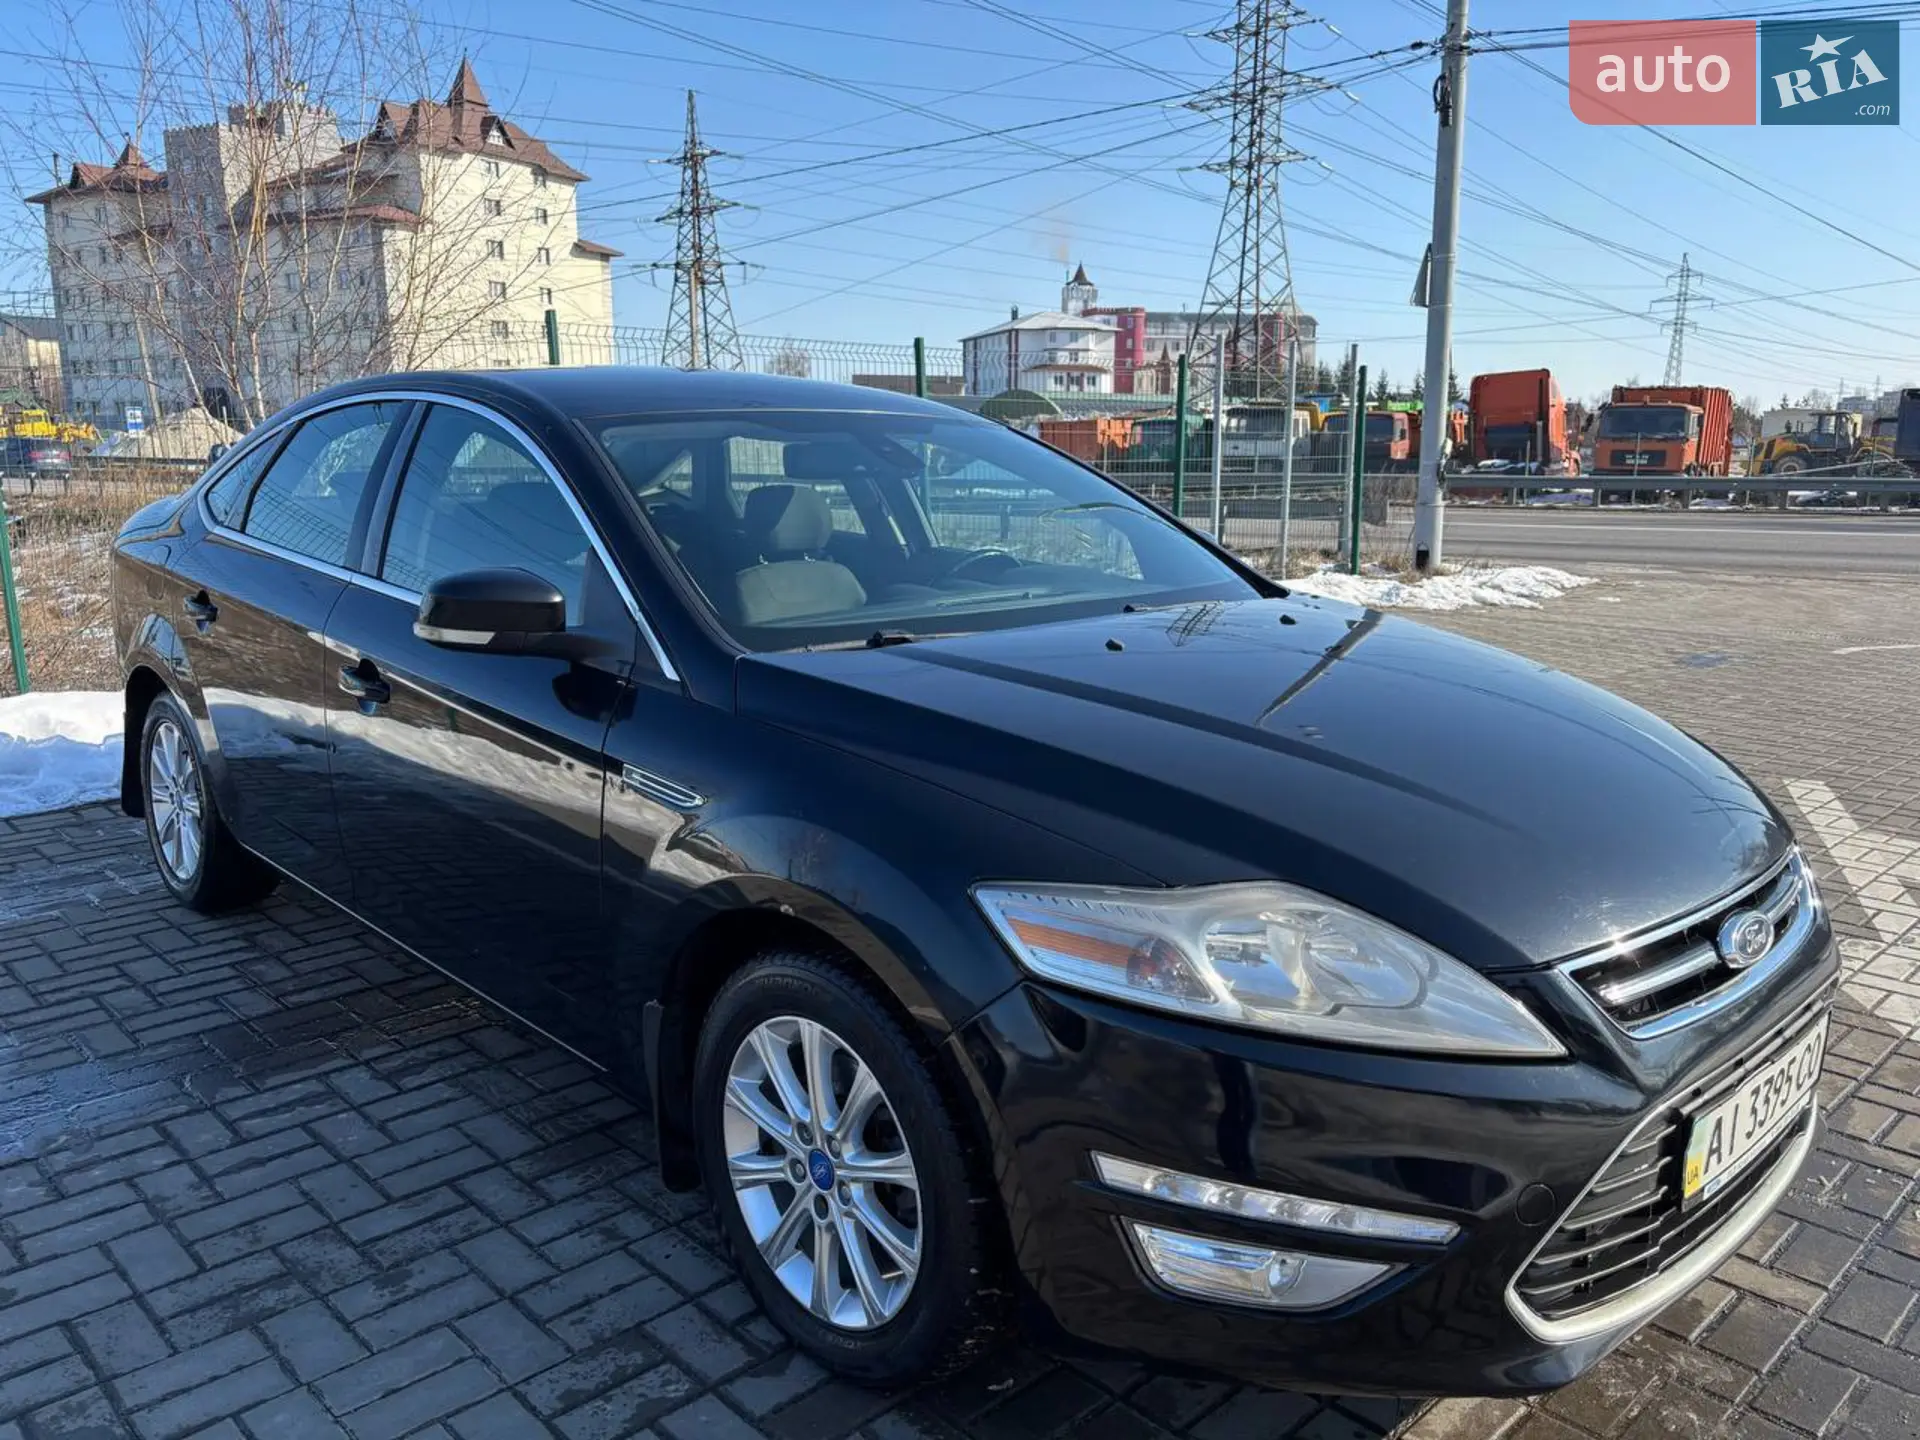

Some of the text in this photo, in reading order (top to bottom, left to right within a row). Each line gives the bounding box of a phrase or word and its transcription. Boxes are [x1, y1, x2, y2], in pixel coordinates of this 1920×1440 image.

[1703, 1103, 1739, 1175] AI
[1745, 1056, 1797, 1140] 3395
[1797, 1031, 1822, 1091] CO
